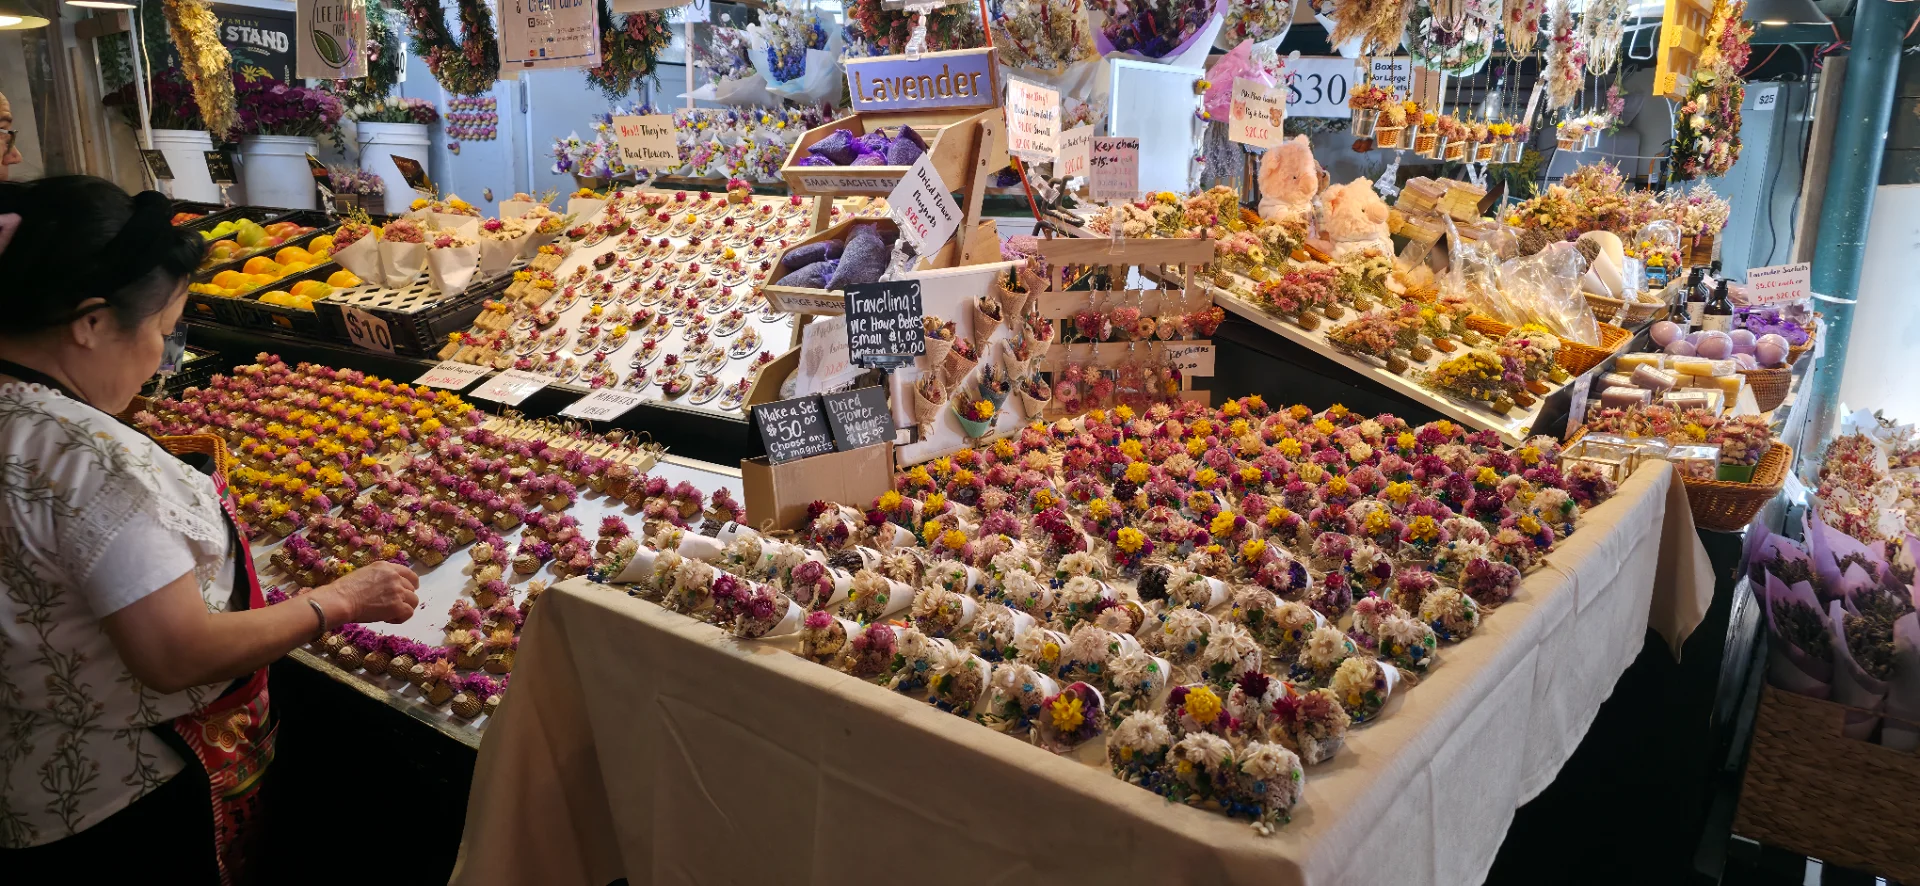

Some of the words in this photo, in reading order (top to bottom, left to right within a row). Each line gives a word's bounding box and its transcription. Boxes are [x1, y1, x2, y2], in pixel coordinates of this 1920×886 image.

[316, 6, 331, 24] LEE
[226, 25, 289, 53] STAND
[1375, 62, 1402, 71] Boxes
[854, 64, 982, 103] Lavender
[1384, 74, 1406, 83] Large
[1286, 73, 1347, 107] $30
[1759, 95, 1775, 105] $25
[620, 124, 640, 137] Yes!!
[640, 124, 669, 139] They're
[1245, 125, 1269, 140] $20.00
[624, 147, 641, 159] Real
[1094, 140, 1114, 153] Key
[804, 178, 836, 187] SMALL
[839, 178, 877, 188] SACHET
[916, 165, 935, 194] Dried
[931, 192, 953, 221] Flower
[911, 189, 937, 228] Magnets
[904, 206, 929, 239] $15.00
[780, 297, 813, 306] LARGE
[813, 299, 846, 310] SACHE
[847, 283, 921, 314] Travelling?
[1776, 290, 1801, 300] $20.00
[346, 311, 391, 350] $10
[850, 319, 868, 335] We
[870, 317, 895, 334] Have
[897, 313, 925, 330] Boxes
[888, 330, 917, 343] $1.00
[890, 340, 925, 354] $2.00
[593, 391, 638, 406] MAGNETS
[829, 393, 862, 414] Dried
[758, 406, 788, 424] Make
[790, 408, 799, 417] a
[798, 400, 819, 415] Set
[836, 406, 874, 423] Flower
[770, 437, 806, 453] Choose
[809, 433, 826, 445] any
[776, 451, 785, 460] 4
[790, 442, 833, 458] magnets
